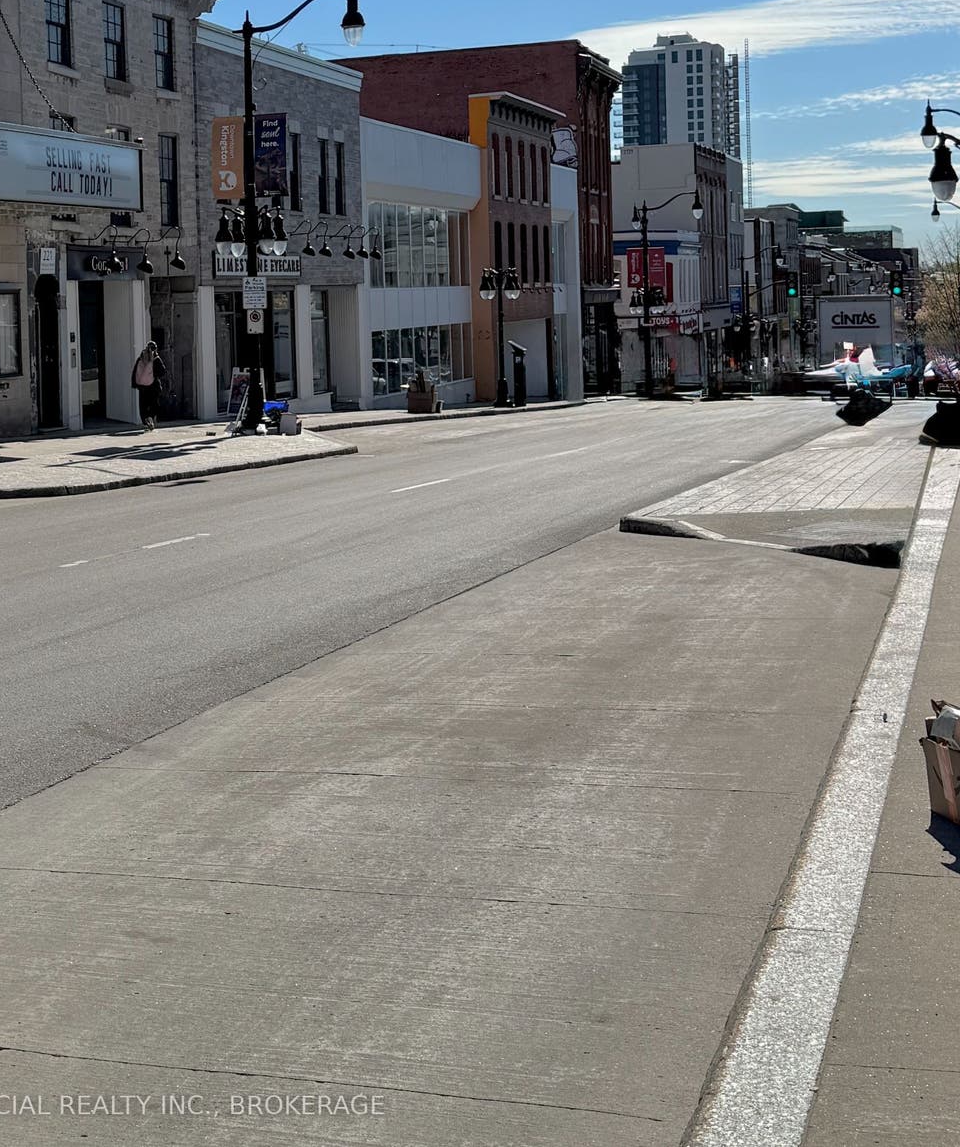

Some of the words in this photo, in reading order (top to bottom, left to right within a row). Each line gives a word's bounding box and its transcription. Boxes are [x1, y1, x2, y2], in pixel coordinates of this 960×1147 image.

[262, 119, 279, 127] Find
[219, 125, 229, 166] Kingston
[45, 146, 82, 171] SELLING
[90, 152, 111, 173] FAST
[51, 171, 73, 193] CALL
[79, 174, 113, 197] TODAY!
[217, 257, 268, 273] LIMESNE
[270, 258, 300, 273] EYECARE
[832, 311, 876, 325] CINTAS
